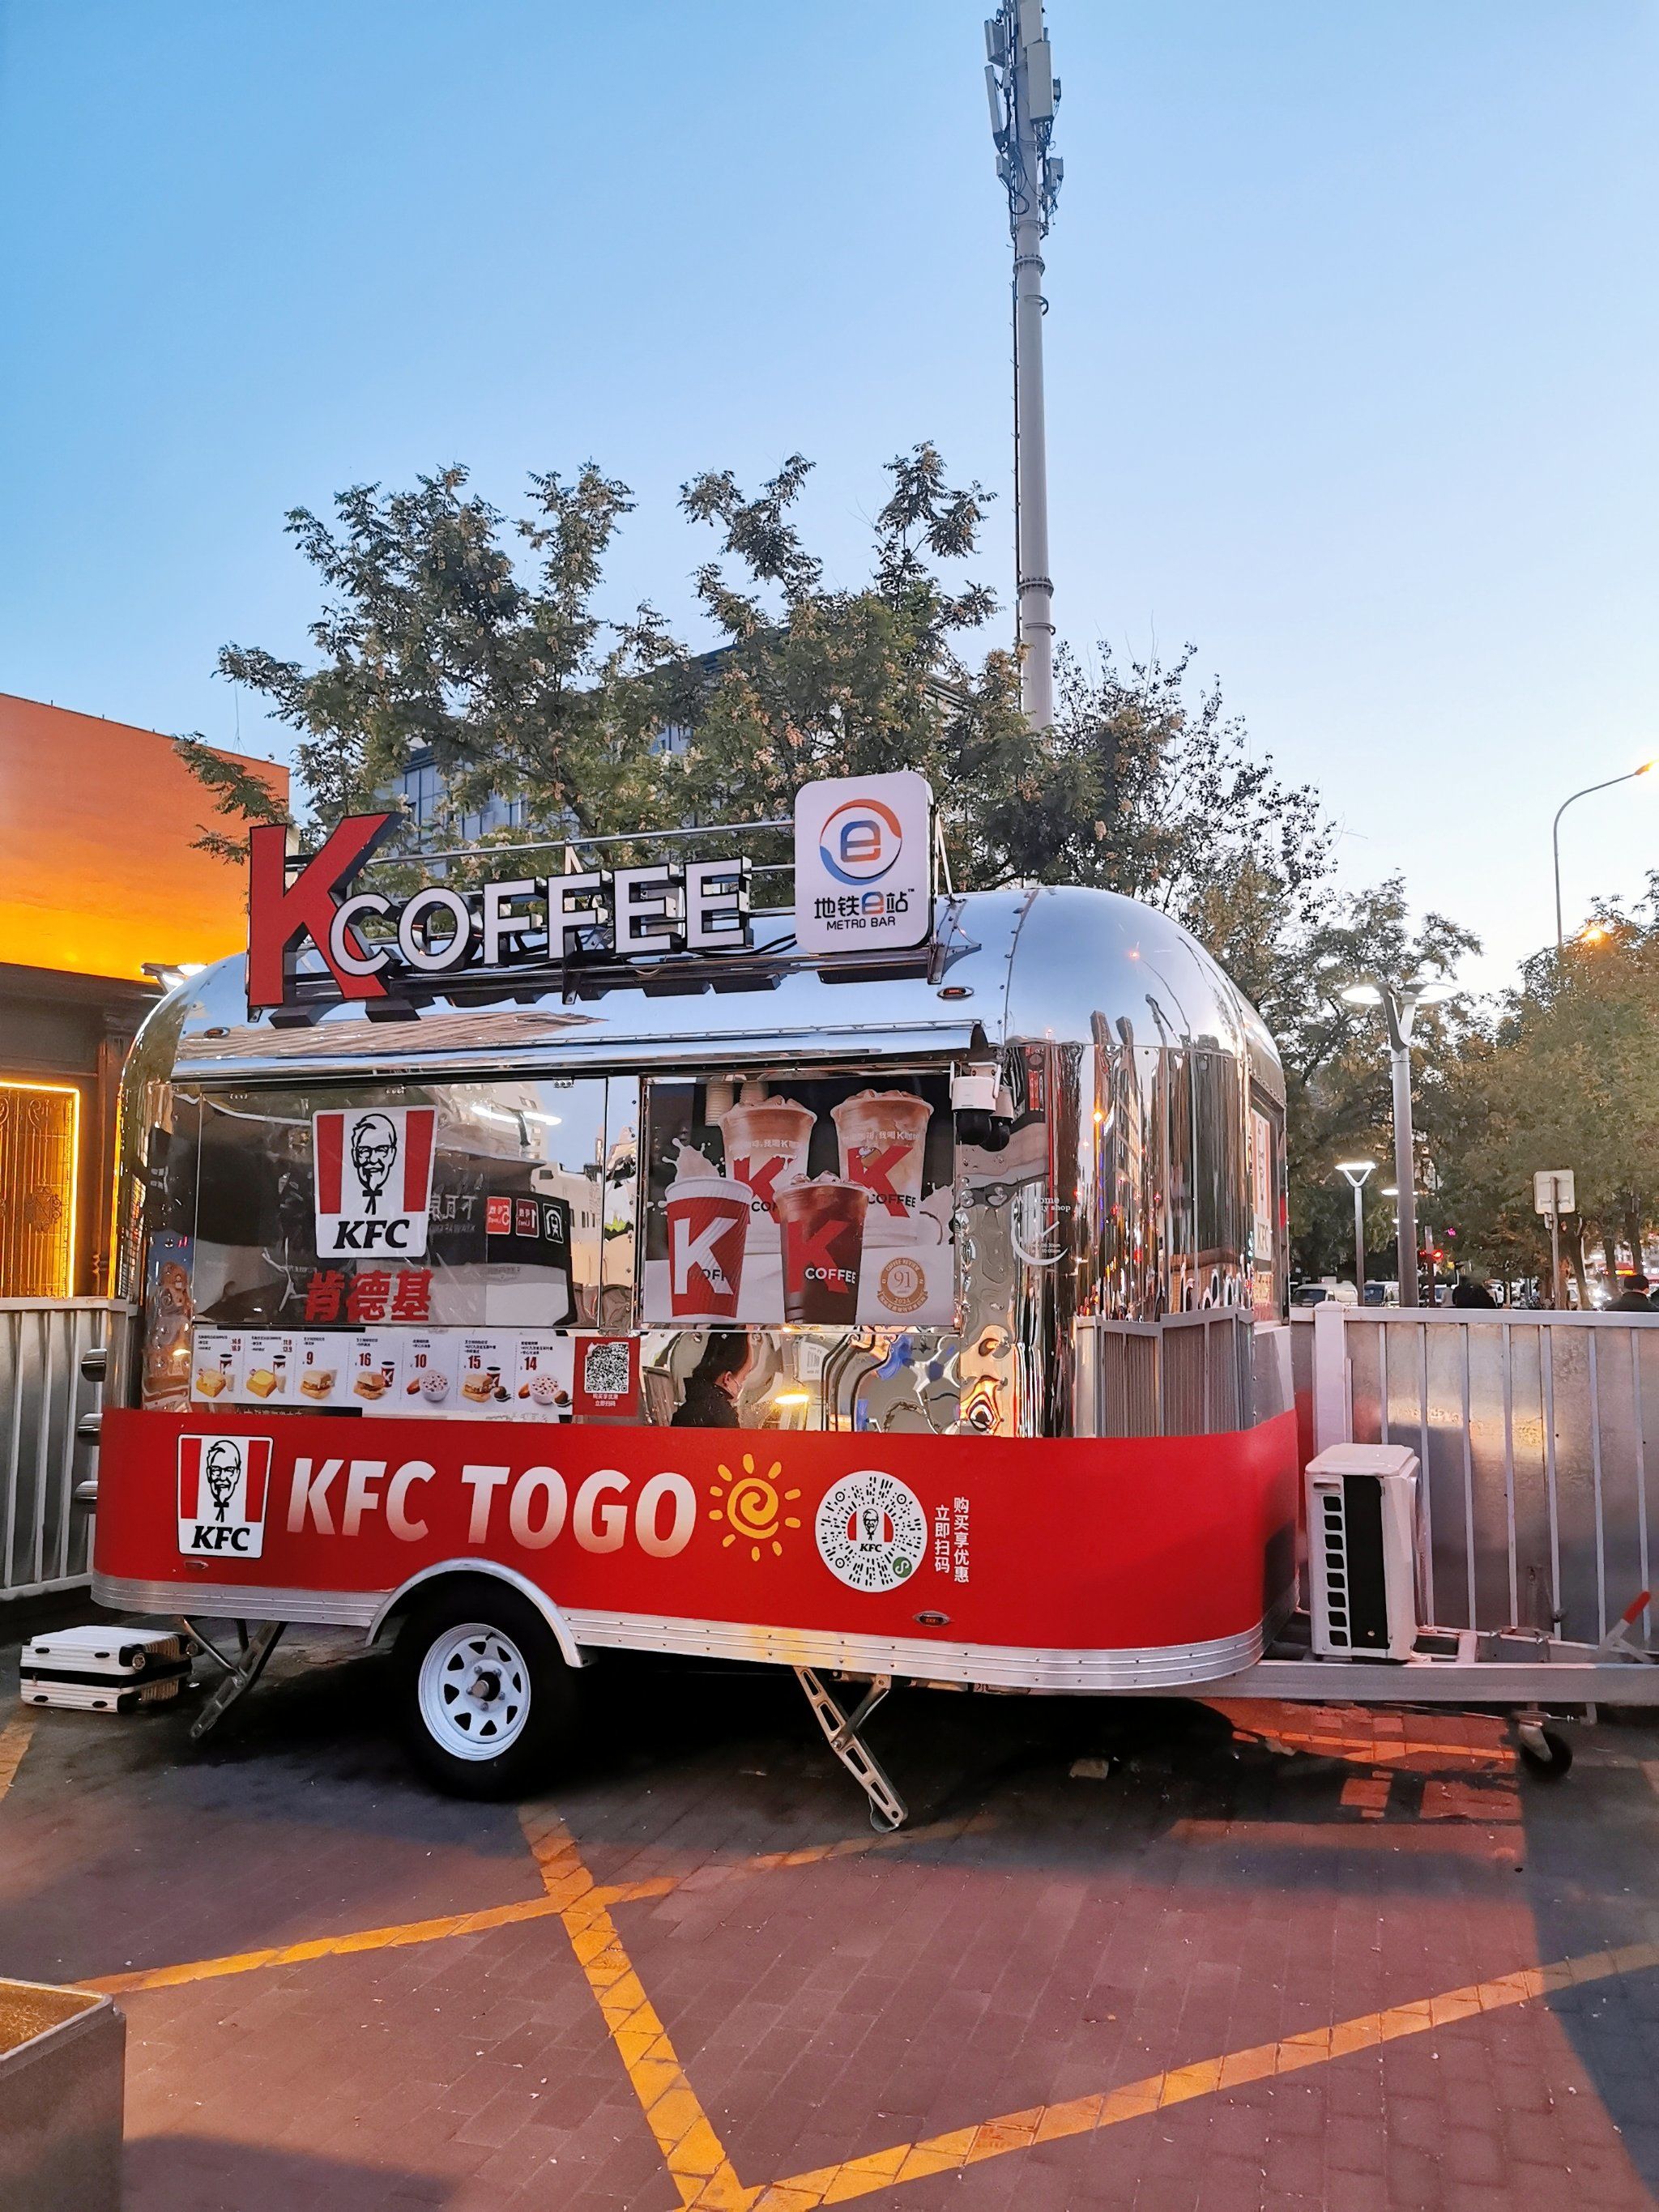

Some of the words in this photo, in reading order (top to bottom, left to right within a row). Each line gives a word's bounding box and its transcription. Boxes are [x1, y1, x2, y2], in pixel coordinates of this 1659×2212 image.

[826, 918, 866, 931] METRO
[871, 916, 895, 927] BAR
[333, 1219, 410, 1249] KFC
[674, 1217, 738, 1294] K
[787, 1220, 850, 1294] K
[804, 1267, 856, 1284] COFFEE
[305, 1270, 434, 1323] 肯德基
[894, 1271, 911, 1289] 91
[287, 1457, 437, 1542] KFC
[461, 1464, 697, 1558] TOGO
[191, 1525, 249, 1552] KFC
[859, 1543, 882, 1553] KFC
[934, 1504, 950, 1574] 立即扫码
[953, 1497, 970, 1583] 购买享优惠
